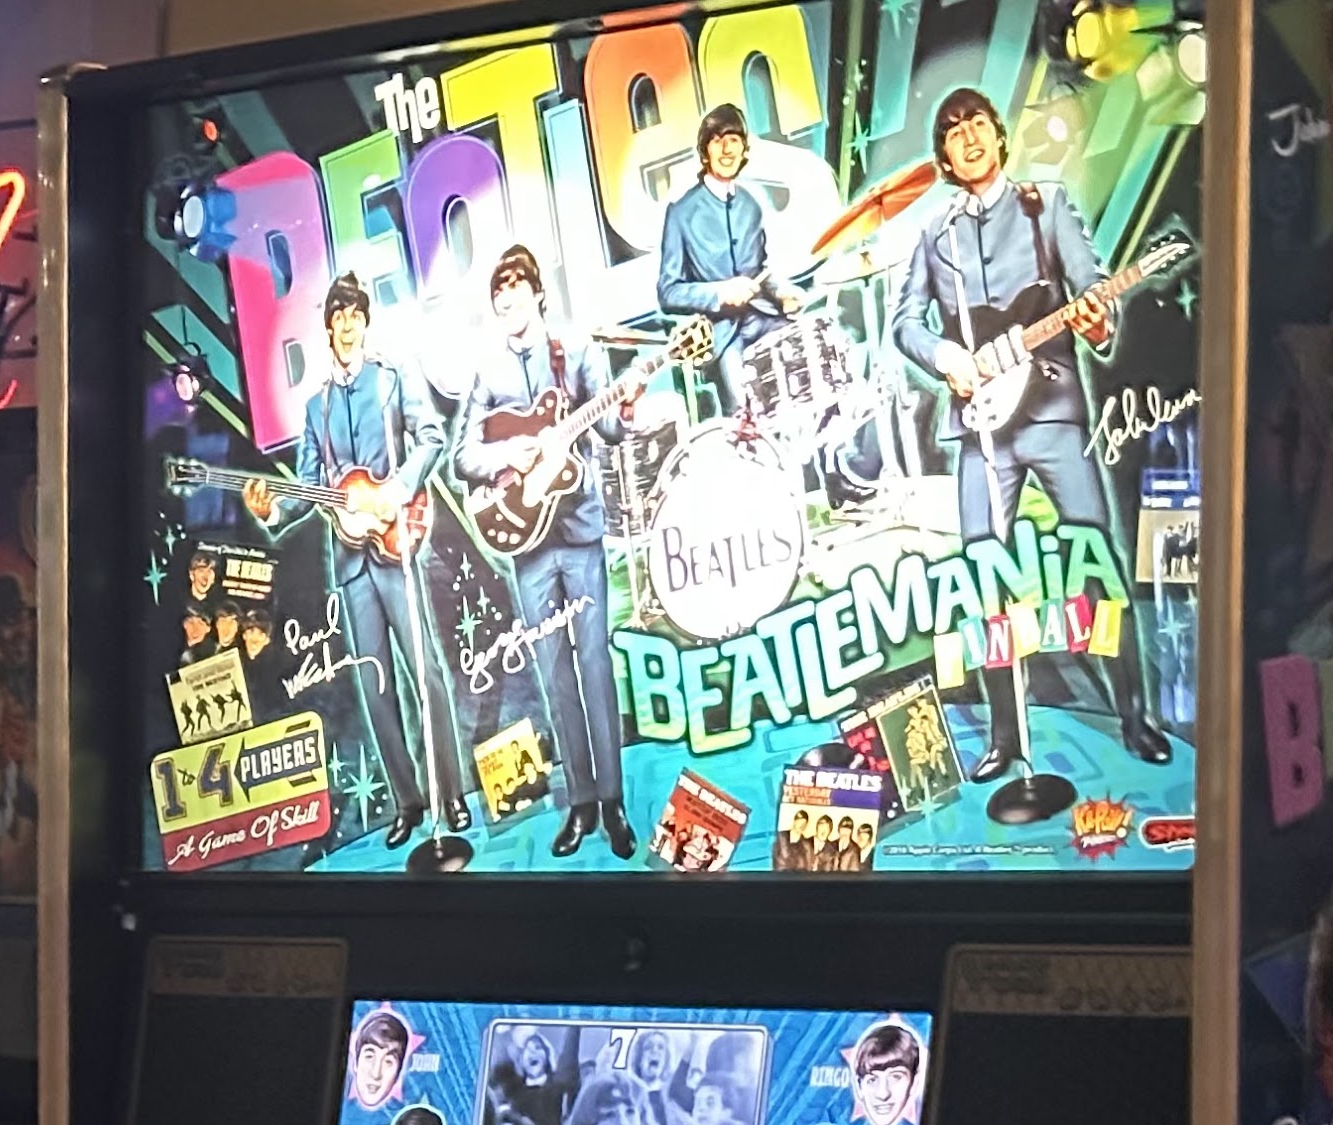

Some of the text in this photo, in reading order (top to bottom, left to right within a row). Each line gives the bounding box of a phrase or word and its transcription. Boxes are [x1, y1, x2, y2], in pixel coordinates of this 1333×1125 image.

[375, 71, 441, 142] The
[661, 526, 793, 594] BEATLES
[283, 592, 342, 655] Paul
[154, 757, 188, 823] 1
[197, 742, 234, 809] 4
[240, 736, 318, 783] PLAYERS
[784, 769, 883, 793] THE BEATLES
[167, 800, 321, 866] A Game Of Skill
[410, 1053, 440, 1072] JOHN
[609, 1028, 637, 1069] 7
[809, 1066, 850, 1088] RINGO
